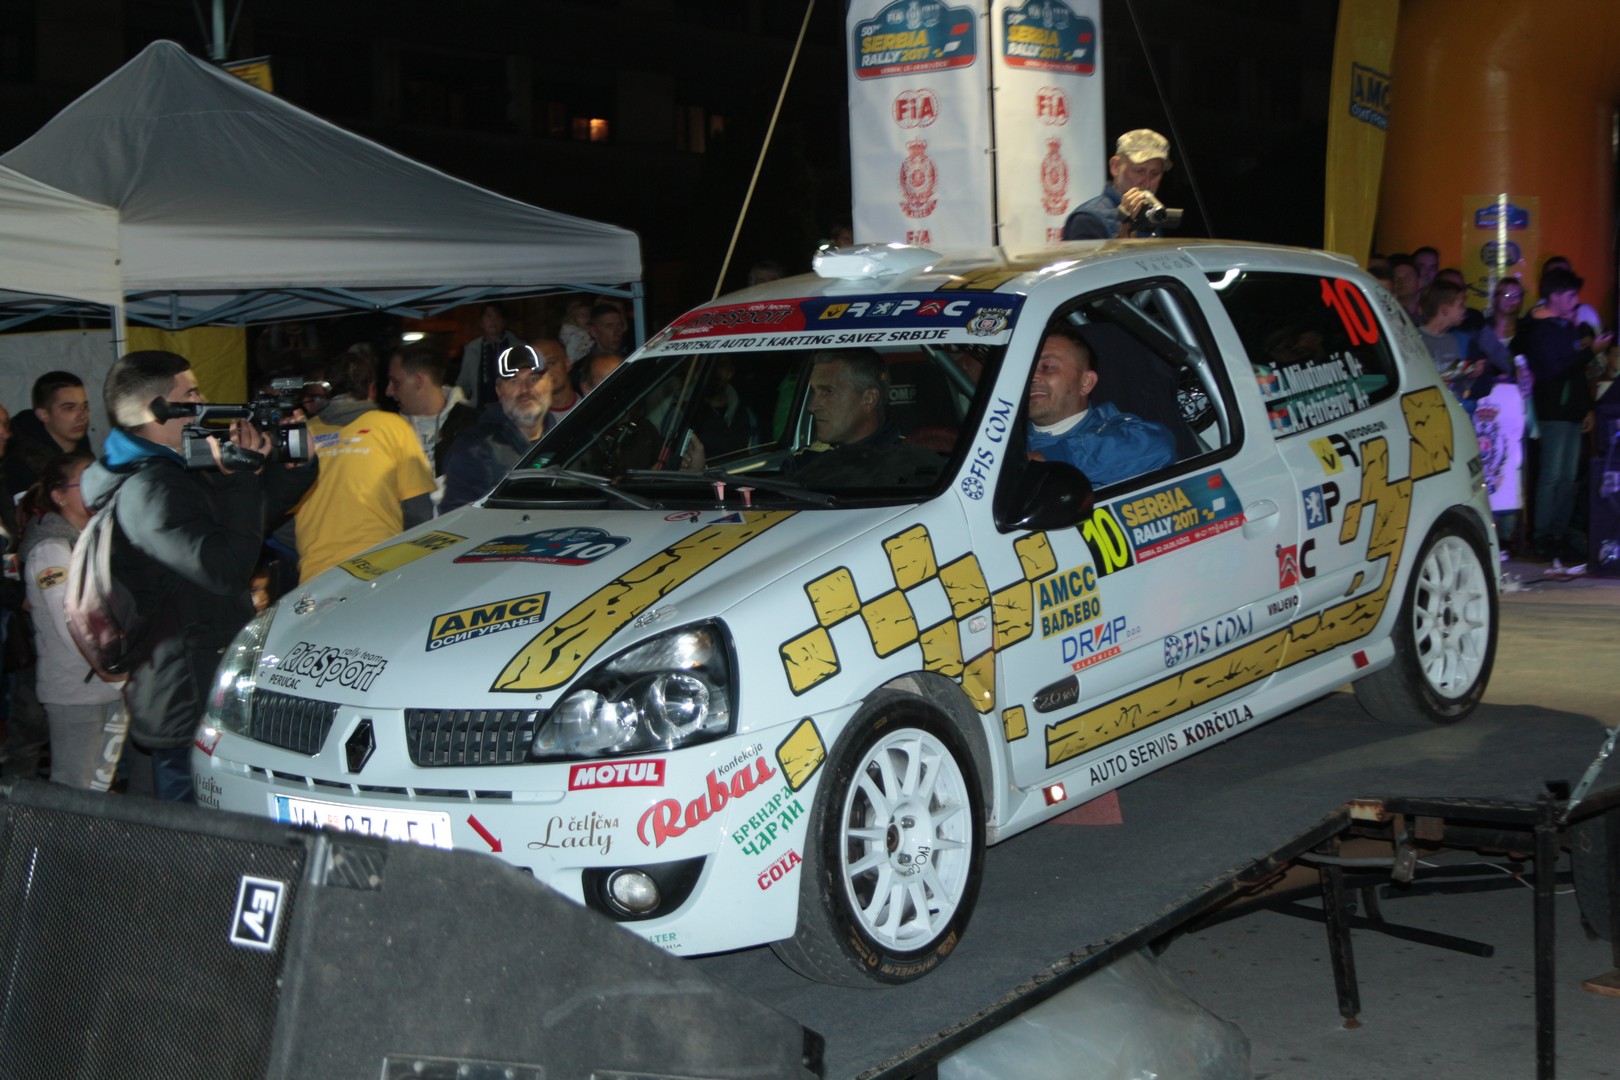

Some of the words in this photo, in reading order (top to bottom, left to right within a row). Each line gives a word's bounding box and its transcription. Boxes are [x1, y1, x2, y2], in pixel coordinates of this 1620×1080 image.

[861, 29, 928, 53] SERBIA
[861, 50, 901, 67] RALLY
[900, 47, 930, 62] 2017
[895, 97, 935, 121] FIA
[1036, 95, 1066, 118] FIA
[1320, 277, 1379, 346] 10
[661, 339, 721, 353] SPORTSKI
[719, 337, 756, 349] AUTO
[756, 337, 767, 347] I
[766, 332, 837, 347] KARTING
[836, 331, 888, 344] SAVEZ
[888, 329, 949, 342] SRBIJE
[889, 386, 916, 400] OMP
[970, 447, 995, 481] FIS
[985, 397, 1014, 443] COM
[1121, 487, 1192, 527] SERBIA
[1082, 508, 1128, 574] 10
[1133, 517, 1174, 545] RALLY
[1172, 508, 1200, 532] 2017
[555, 541, 616, 559] 10
[429, 614, 541, 649] ОСИГУРАЊЕ
[1041, 597, 1100, 637] ВАЉЕВО
[1183, 626, 1212, 658] FIS
[1214, 610, 1253, 649] COM
[341, 647, 361, 659] rally
[360, 651, 383, 662] team
[1062, 616, 1126, 664] DRAP
[1075, 647, 1119, 670] ALATNICA
[276, 641, 388, 692] RidSport
[717, 742, 763, 776] Konfekcija
[1089, 754, 1127, 786] AUTO
[1129, 733, 1178, 768] SERVIS
[1182, 704, 1254, 746] KORČULA
[573, 763, 659, 787] MOTUL
[637, 756, 776, 848] Rabas
[732, 785, 793, 845] БРВНАРА
[527, 815, 614, 856] Lady
[742, 799, 805, 856] ЧАРЛИ
[242, 888, 276, 939] EV
[881, 957, 938, 976] MICHELIN
